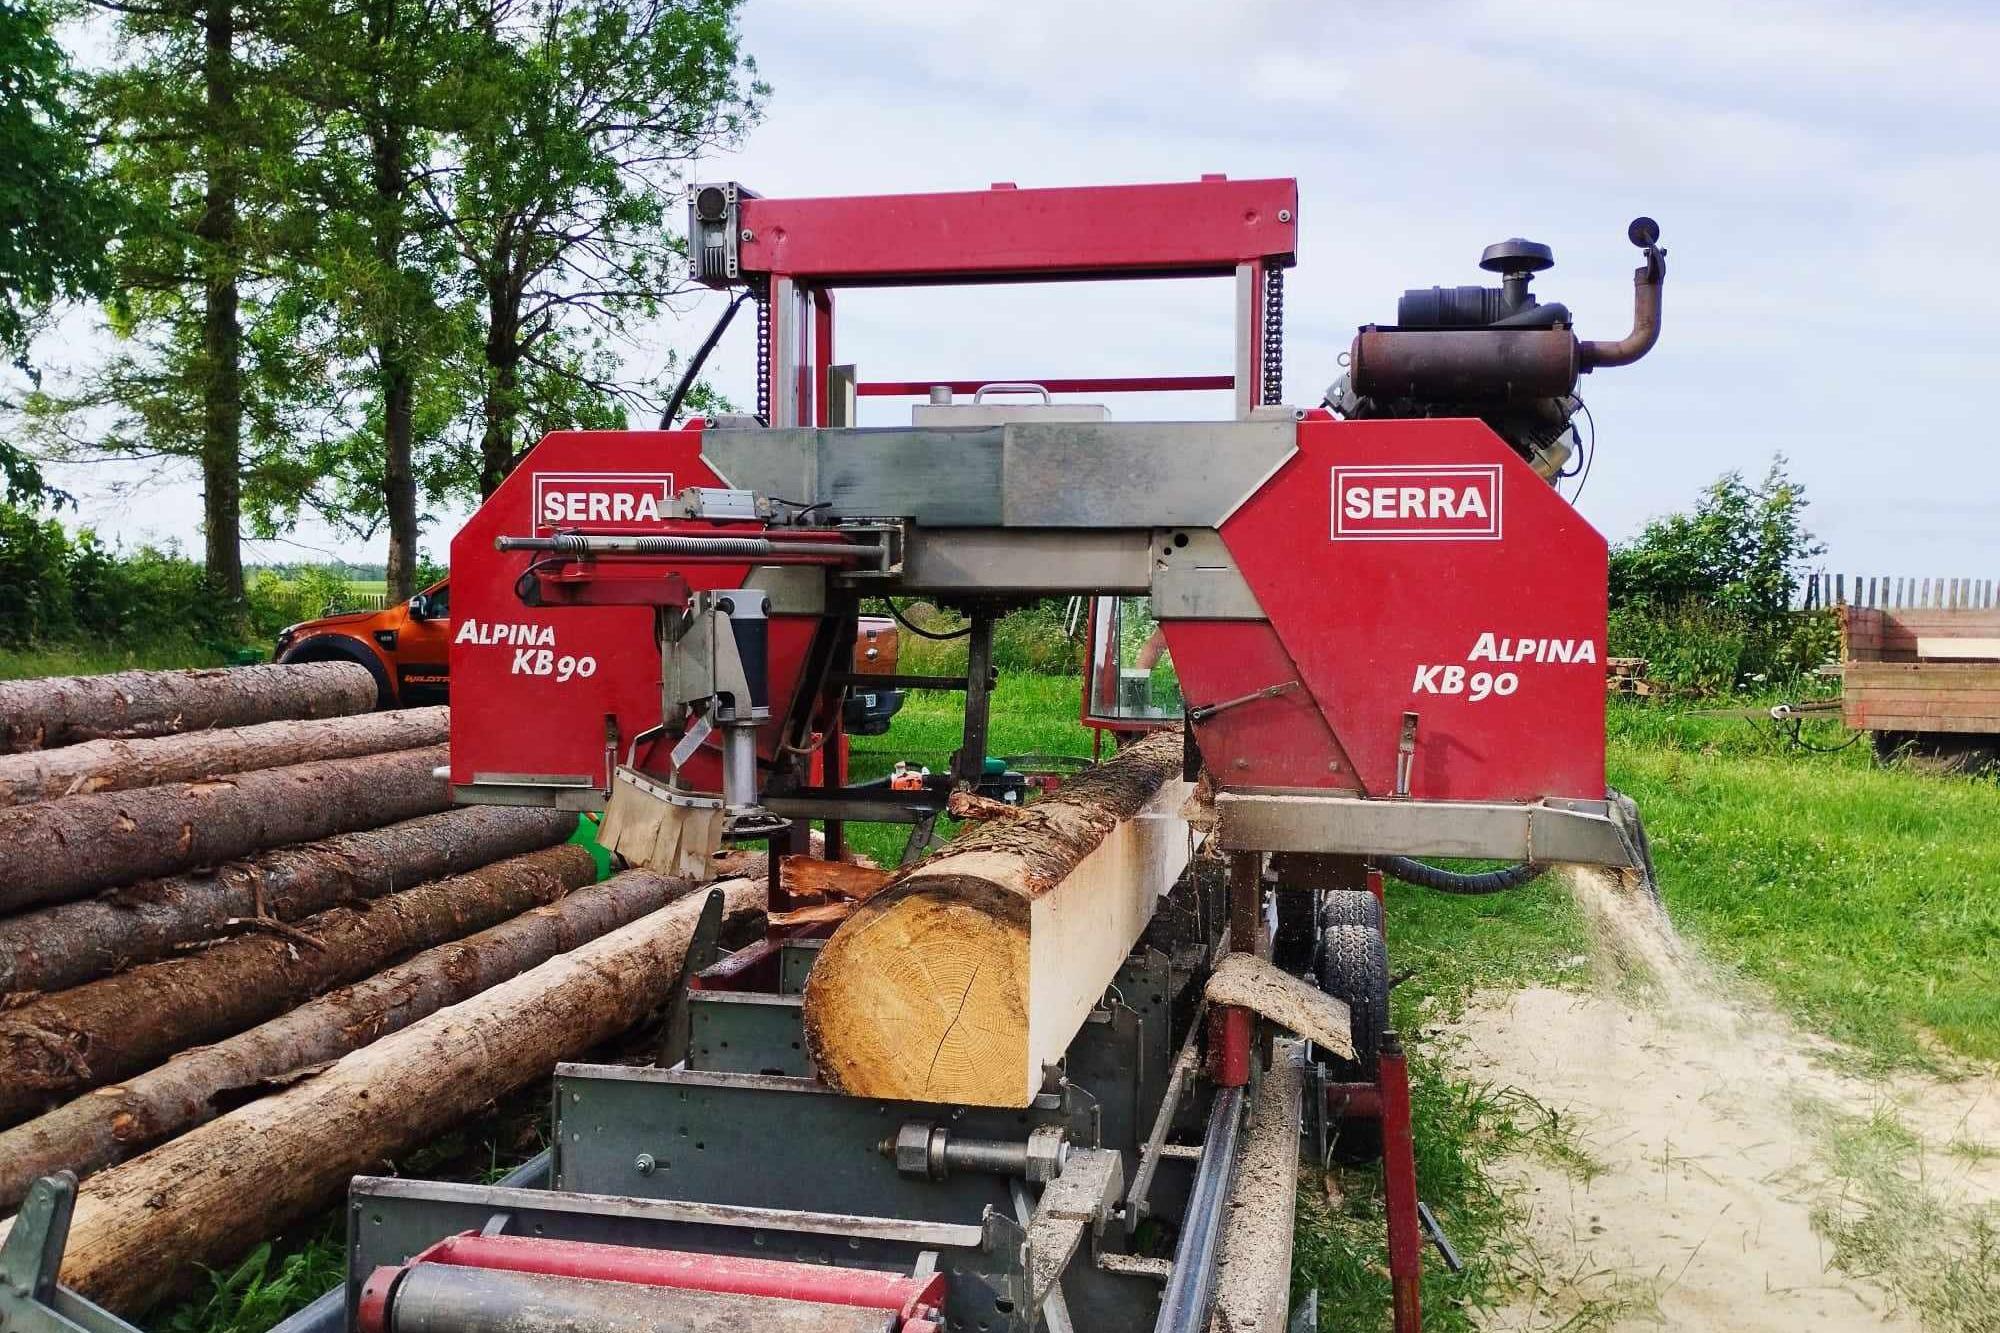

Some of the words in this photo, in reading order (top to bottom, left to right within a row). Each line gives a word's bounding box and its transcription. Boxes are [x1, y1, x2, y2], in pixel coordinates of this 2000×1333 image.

[544, 492, 661, 521] SERRA
[1344, 487, 1487, 519] SERRA
[455, 619, 556, 646] ALPINA
[1467, 633, 1597, 664] ALPINA
